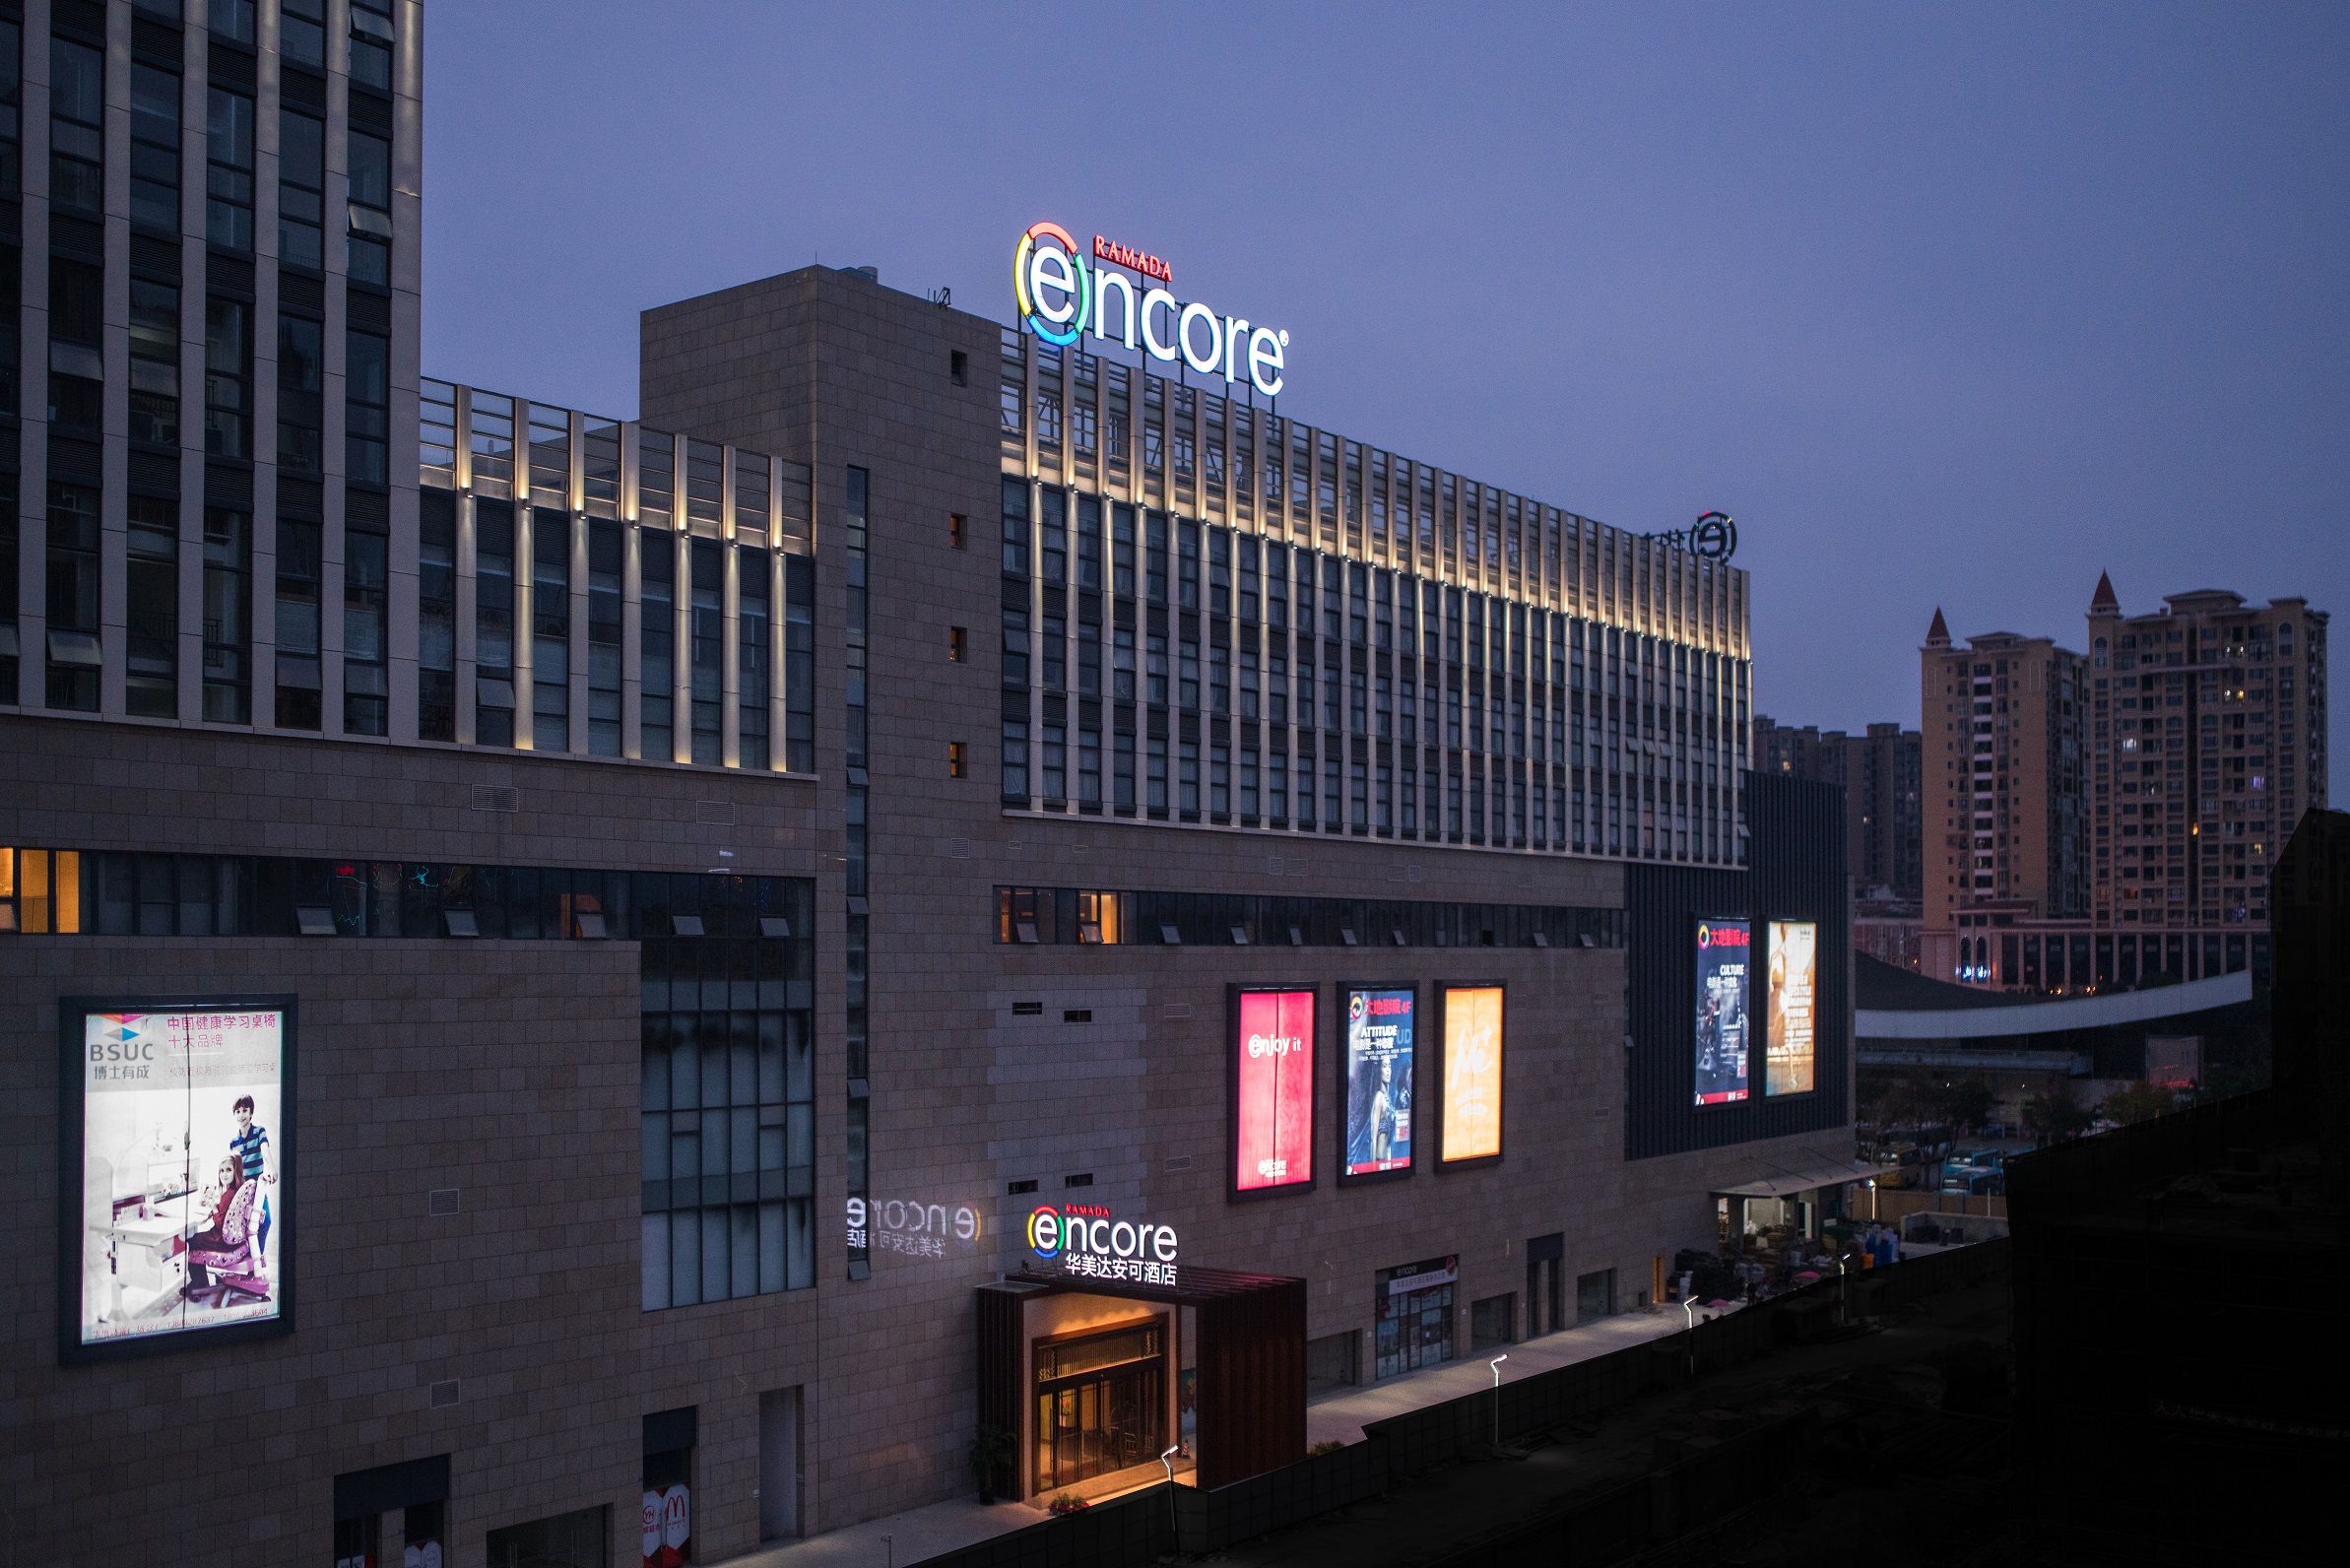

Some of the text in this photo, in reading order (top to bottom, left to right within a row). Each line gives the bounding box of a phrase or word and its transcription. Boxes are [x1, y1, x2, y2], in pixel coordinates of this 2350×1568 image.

[1093, 234, 1172, 282] RAMADA
[1029, 246, 1284, 397] encore
[1710, 928, 1741, 947] 大地影院
[1720, 963, 1744, 976] CULTURE
[1364, 998, 1411, 1015] 大地影院 4F
[167, 1013, 277, 1031] 中国健康学习桌椅
[1360, 1024, 1398, 1038] ATTITUDE
[167, 1033, 224, 1049] 十大品牌
[1249, 1033, 1302, 1058] enjoy it
[90, 1043, 155, 1062] BSUC
[94, 1065, 150, 1081] 博士有成
[1065, 1204, 1110, 1218] RAMADA
[1035, 1214, 1178, 1262] encore
[1066, 1252, 1178, 1286] 华美达安可酒店
